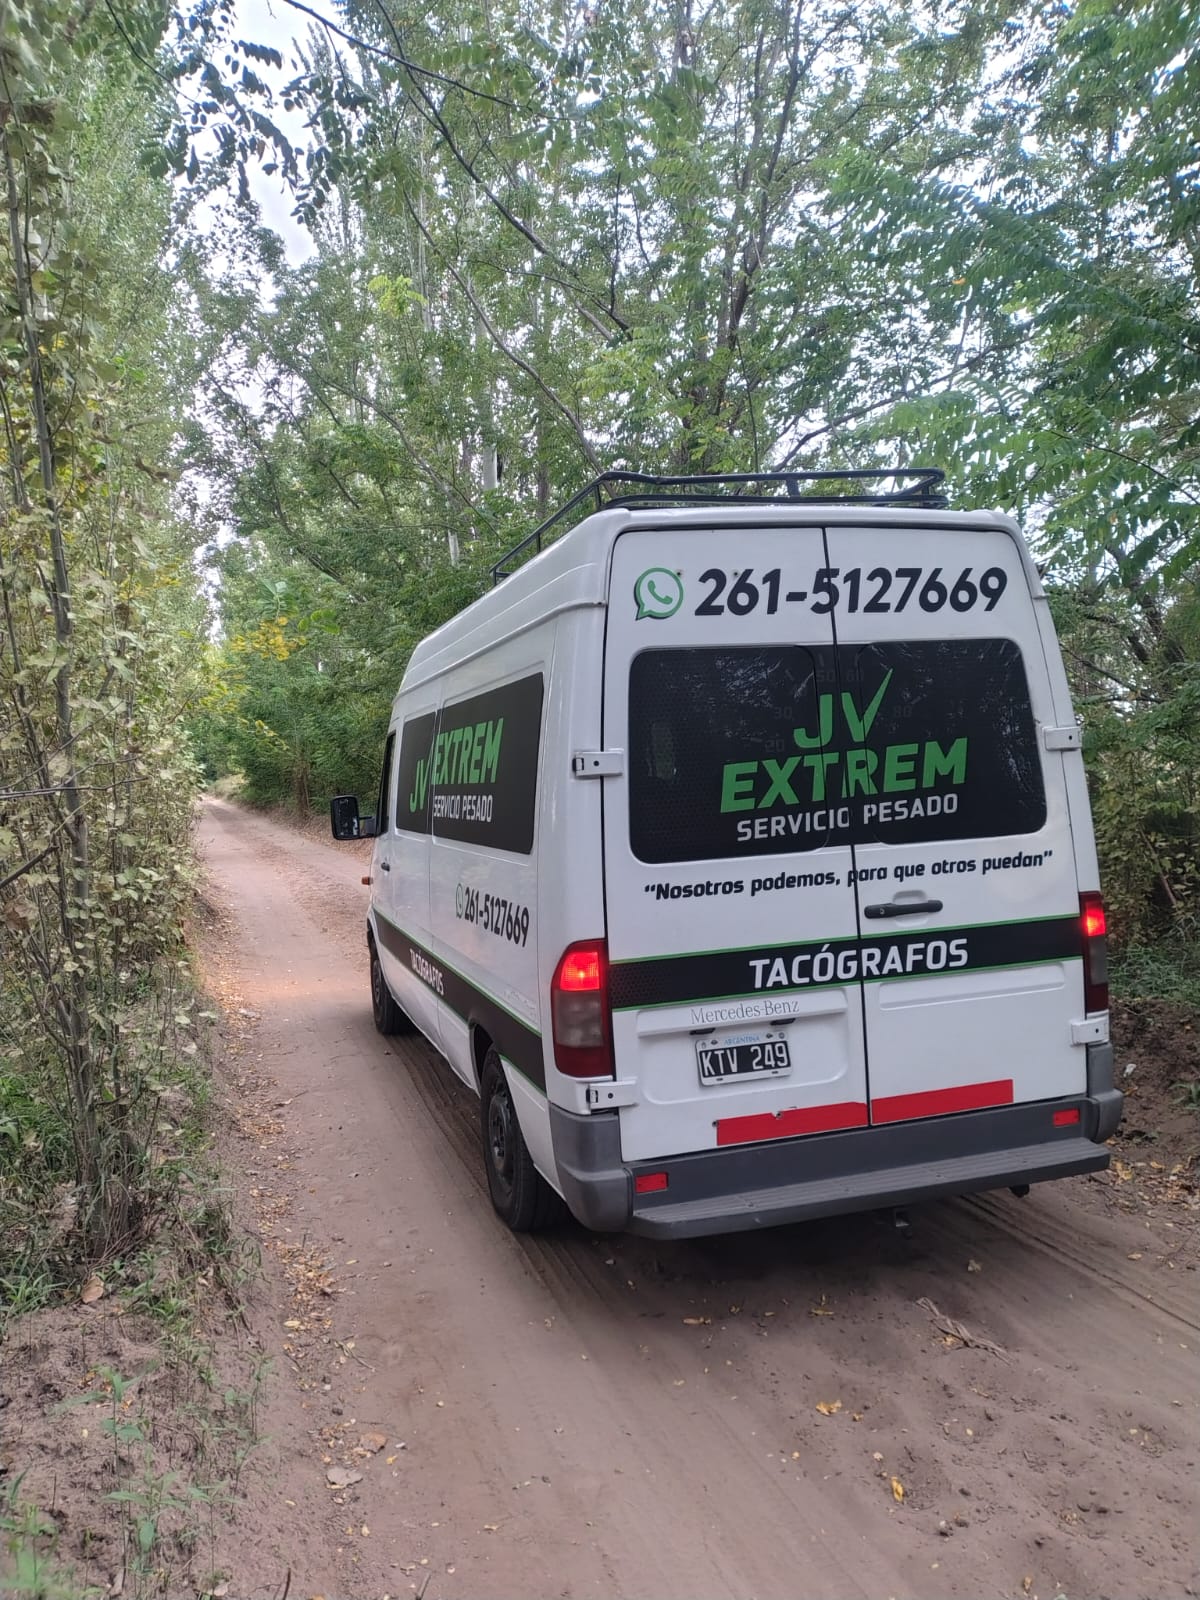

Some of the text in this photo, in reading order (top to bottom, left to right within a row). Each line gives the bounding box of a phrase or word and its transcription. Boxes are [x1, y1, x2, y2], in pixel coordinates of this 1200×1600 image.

[694, 567, 1008, 616] 261-5127669
[793, 668, 893, 749] JV
[431, 717, 504, 786] EXTREM
[720, 736, 969, 814] EXTREM
[409, 746, 433, 814] JV
[433, 794, 494, 823] SERVICIO PESADO
[736, 793, 959, 842] SERVICIO PESADO
[750, 872, 842, 897] podemos,
[847, 864, 888, 887] para
[893, 861, 926, 882] que
[931, 857, 978, 875] otros
[464, 886, 530, 948] 261-5127669
[409, 948, 445, 996] TACÓGRAFOS
[749, 938, 969, 989] TACÓGRAFOS
[690, 1000, 800, 1025] Mercedes-Benz
[701, 1043, 789, 1077] KTV 249
